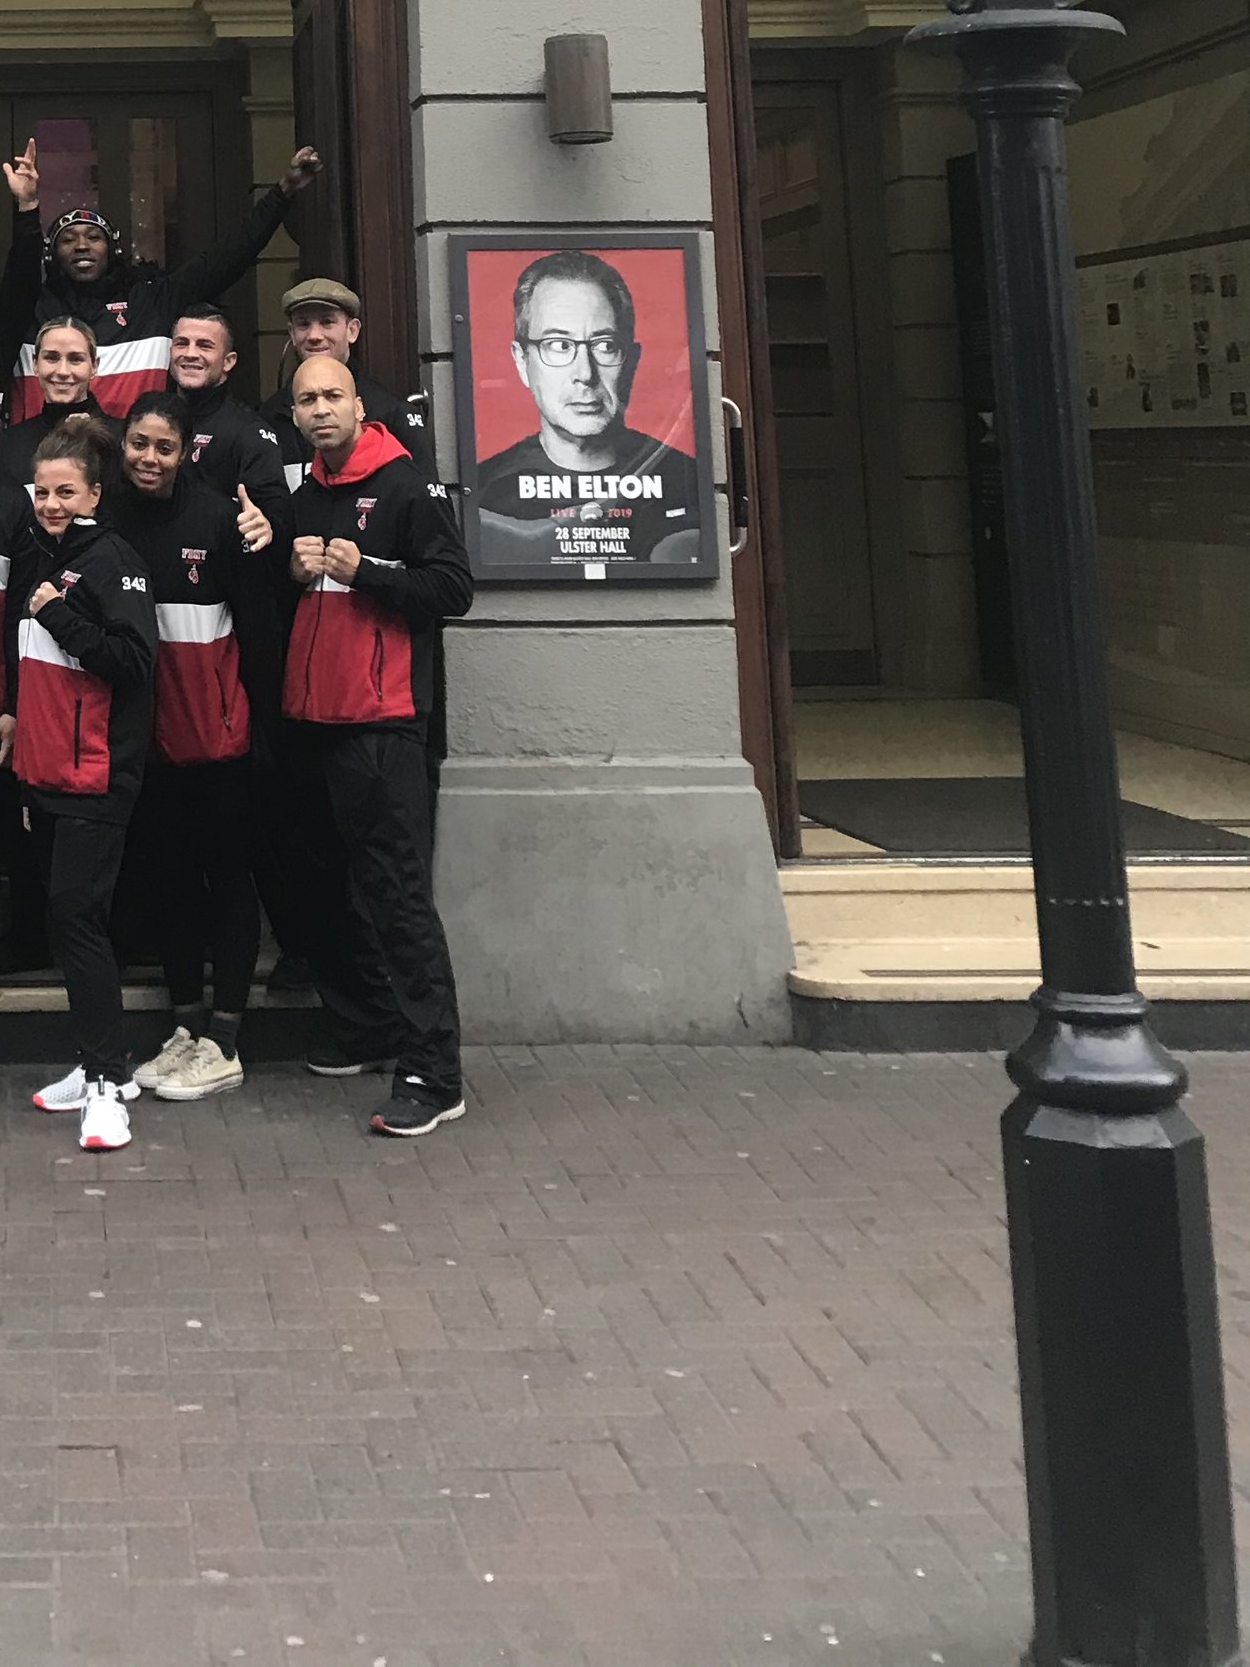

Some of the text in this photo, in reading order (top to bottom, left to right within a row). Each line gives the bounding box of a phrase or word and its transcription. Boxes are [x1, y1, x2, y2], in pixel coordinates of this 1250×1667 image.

[518, 475, 663, 500] BEN ELTON
[550, 508, 633, 518] LIVE 2019
[555, 527, 631, 540] 28 SEPTEMBER
[560, 541, 626, 553] ULSTER HALL
[121, 576, 147, 592] 343
